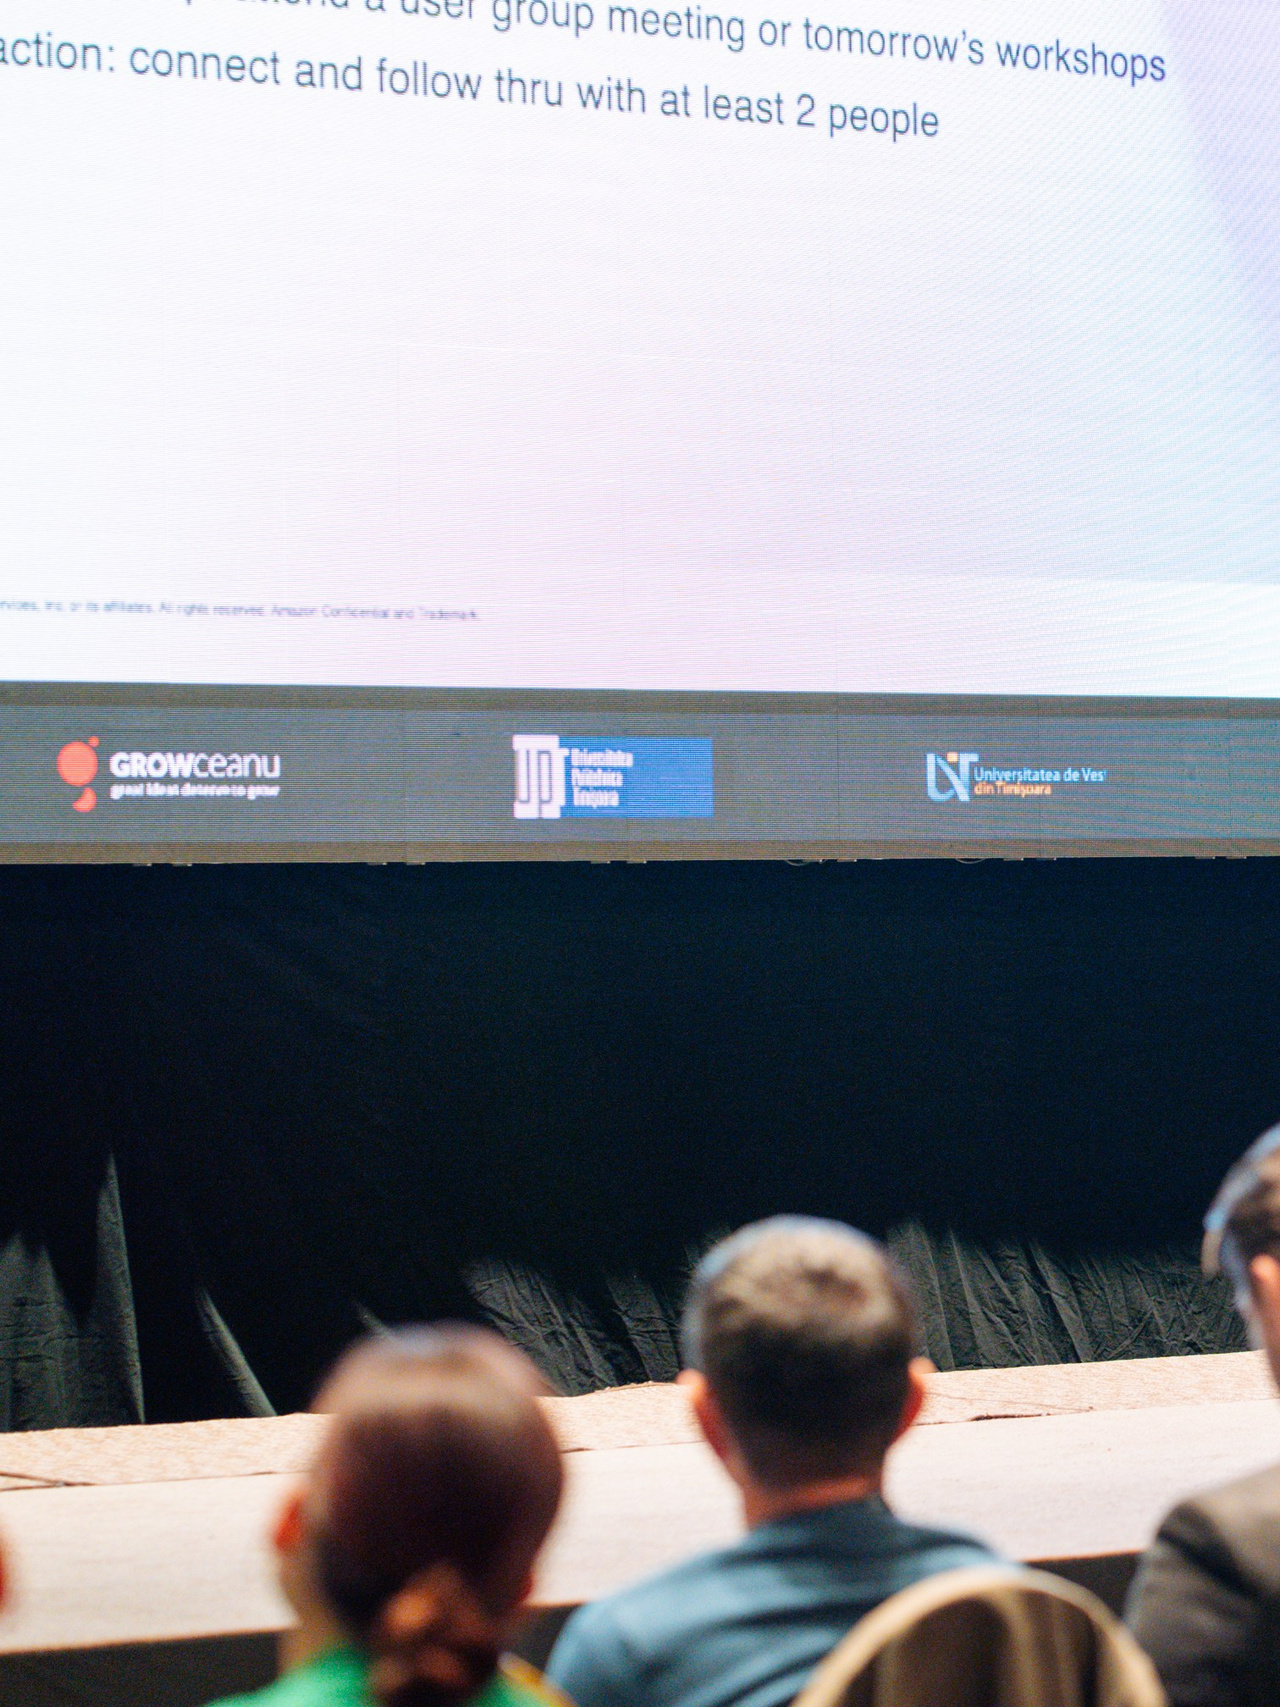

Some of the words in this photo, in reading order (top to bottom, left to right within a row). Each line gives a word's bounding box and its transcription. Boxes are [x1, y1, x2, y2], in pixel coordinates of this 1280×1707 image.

[492, 0, 594, 38] group
[608, 7, 745, 53] meeting
[759, 19, 791, 46] or
[803, 18, 985, 66] tomorrow's
[995, 38, 1167, 88] workshops
[129, 47, 280, 85] connect
[295, 56, 363, 91] and
[376, 57, 482, 100] follow
[495, 68, 563, 107] thru
[576, 78, 646, 113] with
[660, 85, 691, 118] at
[704, 85, 784, 125] least
[796, 93, 816, 128] 2
[829, 102, 939, 143] people
[109, 752, 281, 778] GROWceanu
[974, 766, 1060, 783] Universitatea
[1063, 767, 1079, 783] de
[974, 782, 994, 795] din
